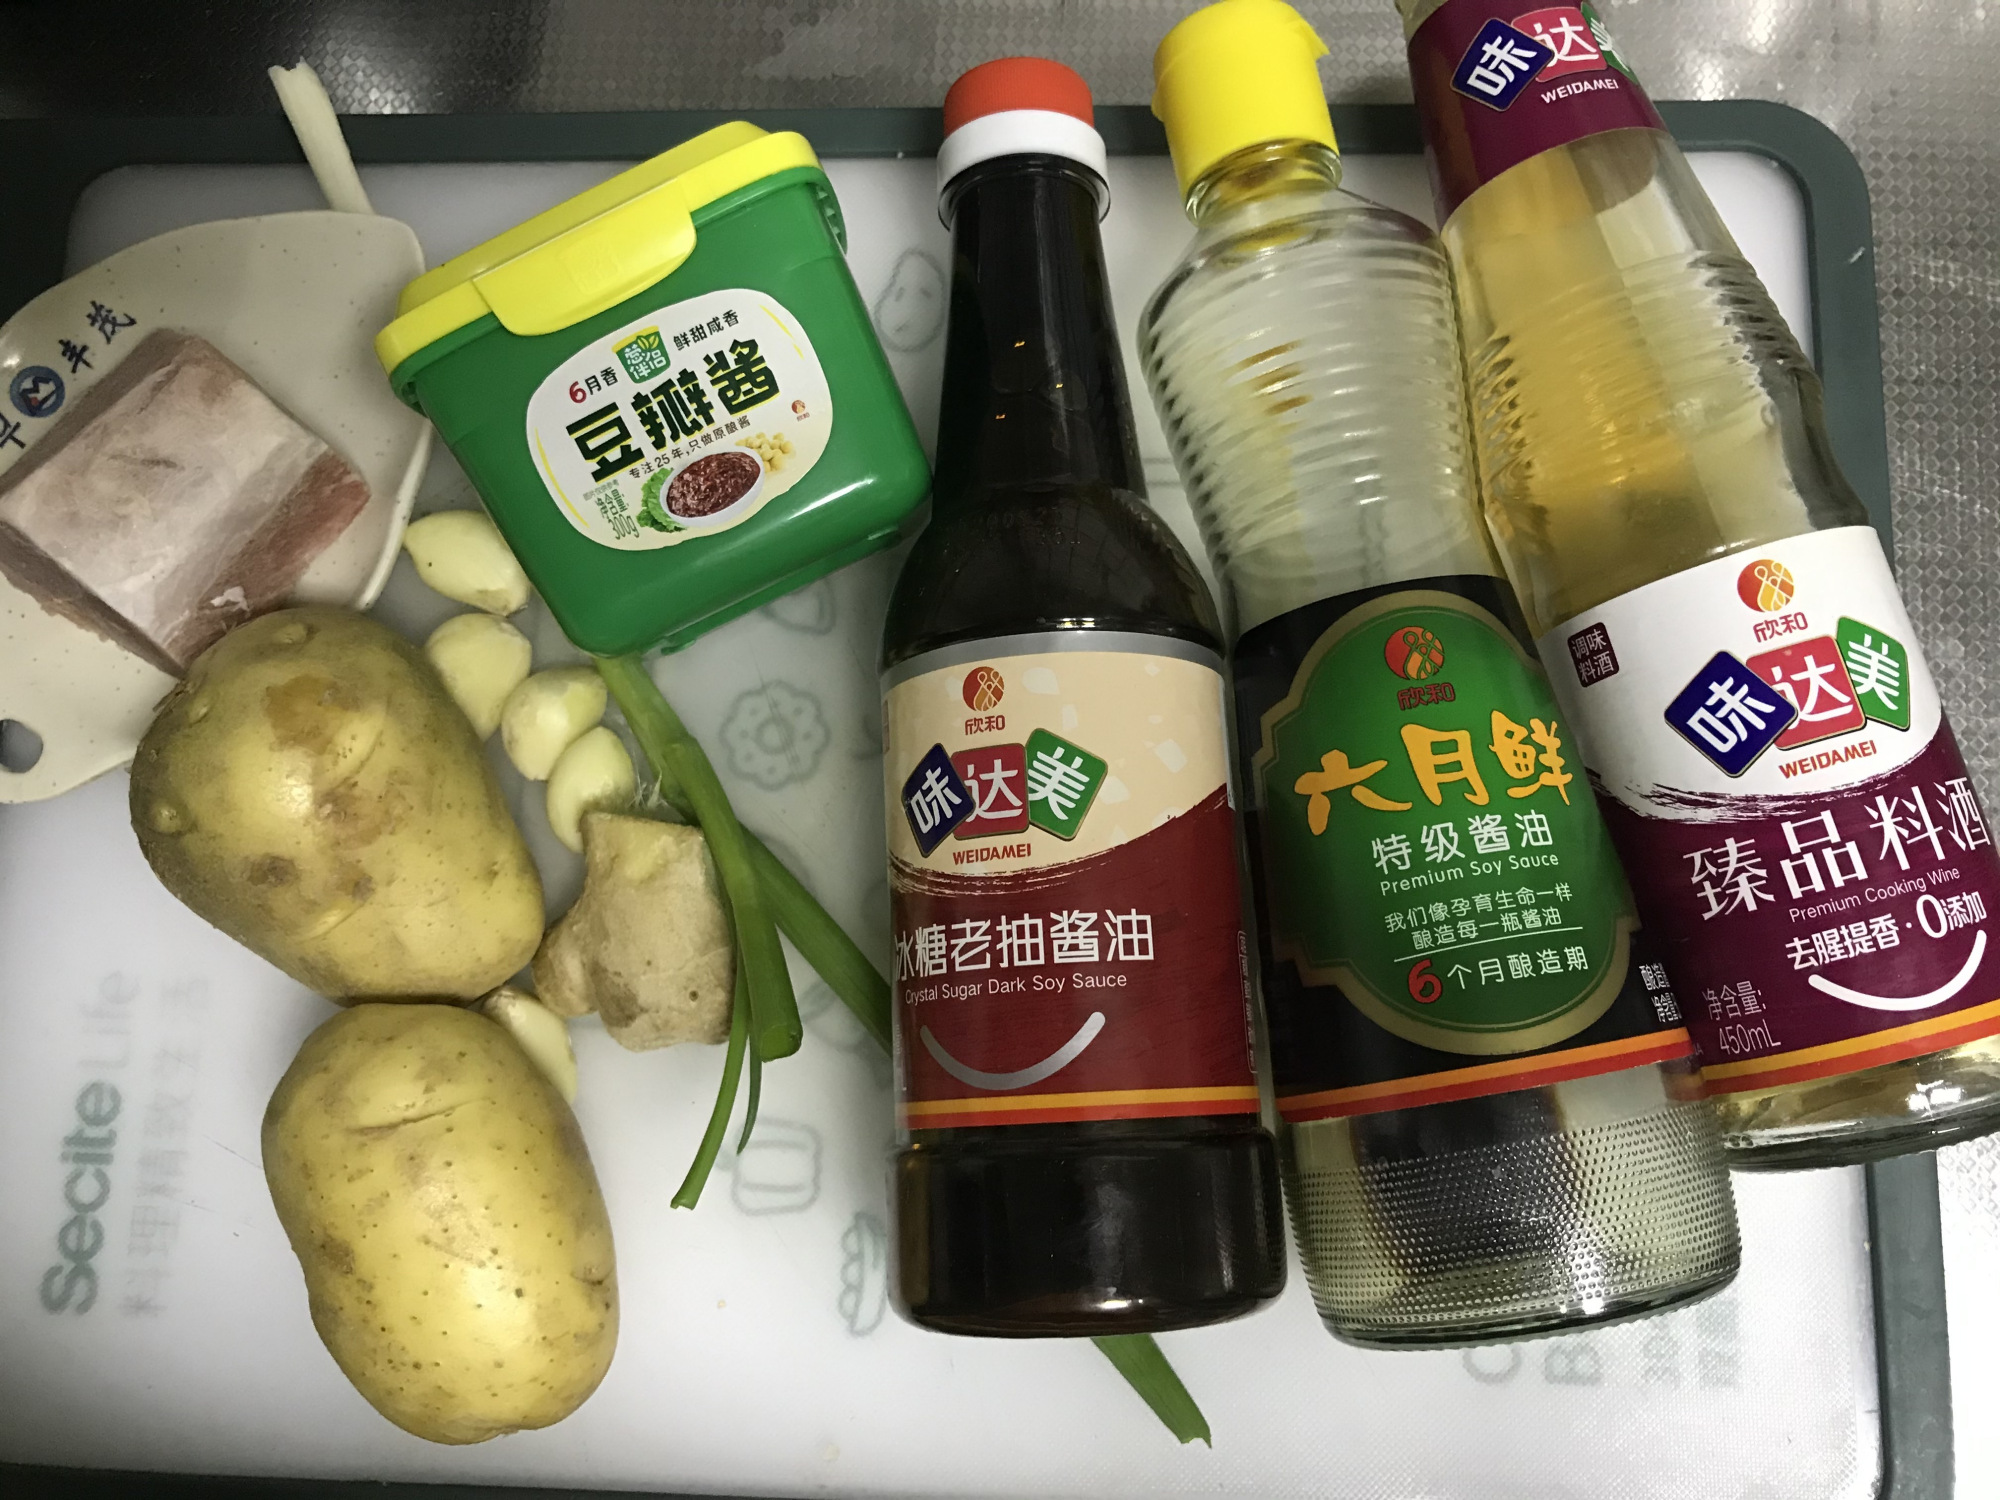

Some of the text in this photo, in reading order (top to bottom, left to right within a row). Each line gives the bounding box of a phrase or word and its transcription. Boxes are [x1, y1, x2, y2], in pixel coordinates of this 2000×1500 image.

[1541, 79, 1619, 104] WEIDAMEI
[673, 309, 740, 350] 鲜甜咸香
[568, 367, 619, 404] 6月香
[565, 338, 780, 484] 豆瓣酱
[608, 514, 640, 540] 300g
[1571, 629, 1607, 660] 调味
[1753, 612, 1809, 643] 欣和
[1577, 651, 1615, 683] 料酒
[1397, 682, 1456, 711] 欣和
[1686, 634, 1900, 753] 味达美
[964, 715, 1006, 735] 欣和
[1294, 709, 1573, 836] 六月鲜
[1779, 740, 1878, 779] WEIDAMEI
[910, 746, 1090, 834] 味达美
[952, 843, 1032, 865] WEIDAMEI
[1371, 809, 1554, 875] 特级酱油
[1683, 776, 1991, 921] 臻品料酒
[1380, 852, 1560, 896] Premium Soy Sauce
[1789, 866, 1961, 922] Premium Cooking Wine
[1384, 882, 1573, 933] 我们像孕育生命一样
[1411, 906, 1562, 950] 酿造每一瓶酱油
[895, 908, 1155, 982] 冰糖老抽酱油
[904, 972, 1128, 1007] Crystal Sugar Dark Soy Sauce
[1407, 946, 1589, 1004] 6个月酿造期
[1719, 1018, 1782, 1055] 450mL
